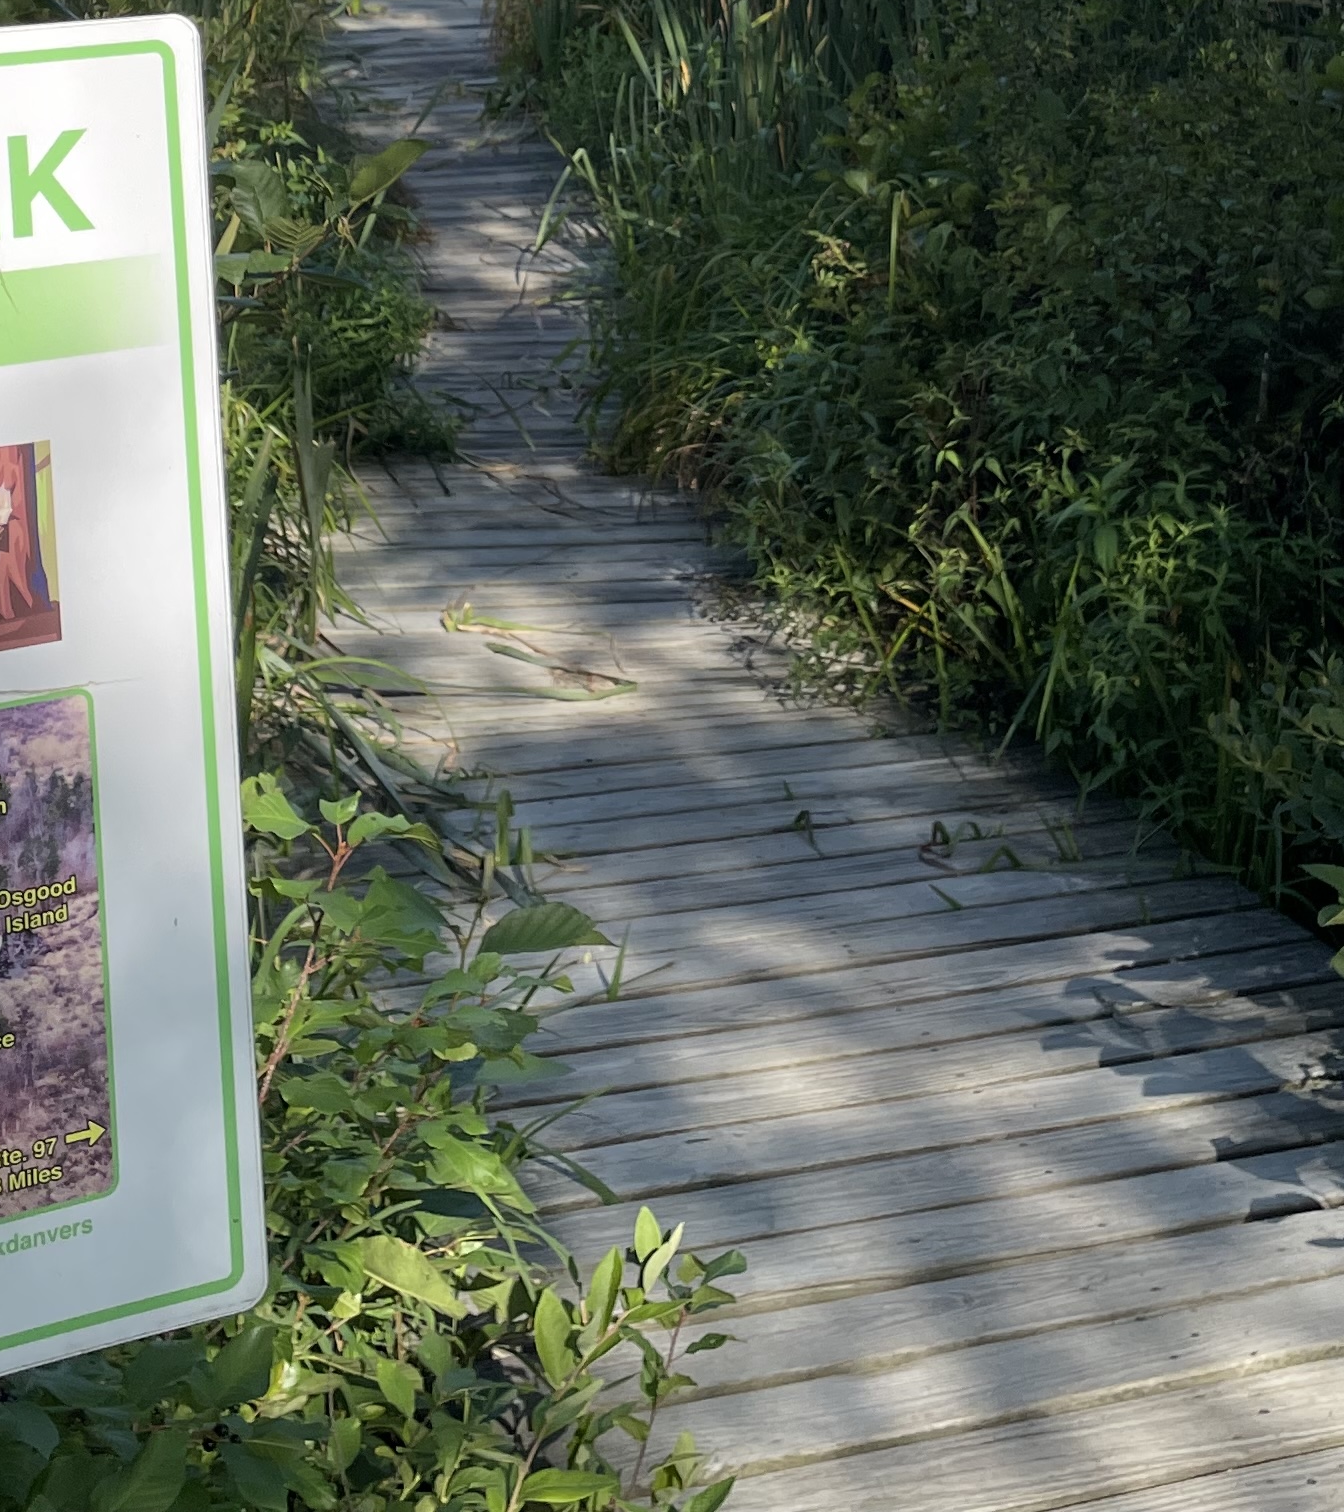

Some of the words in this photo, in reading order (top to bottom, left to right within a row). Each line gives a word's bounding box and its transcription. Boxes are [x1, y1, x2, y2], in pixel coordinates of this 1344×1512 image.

[5, 904, 69, 935] Island
[32, 1137, 58, 1159] 97
[7, 1164, 63, 1192] Miles
